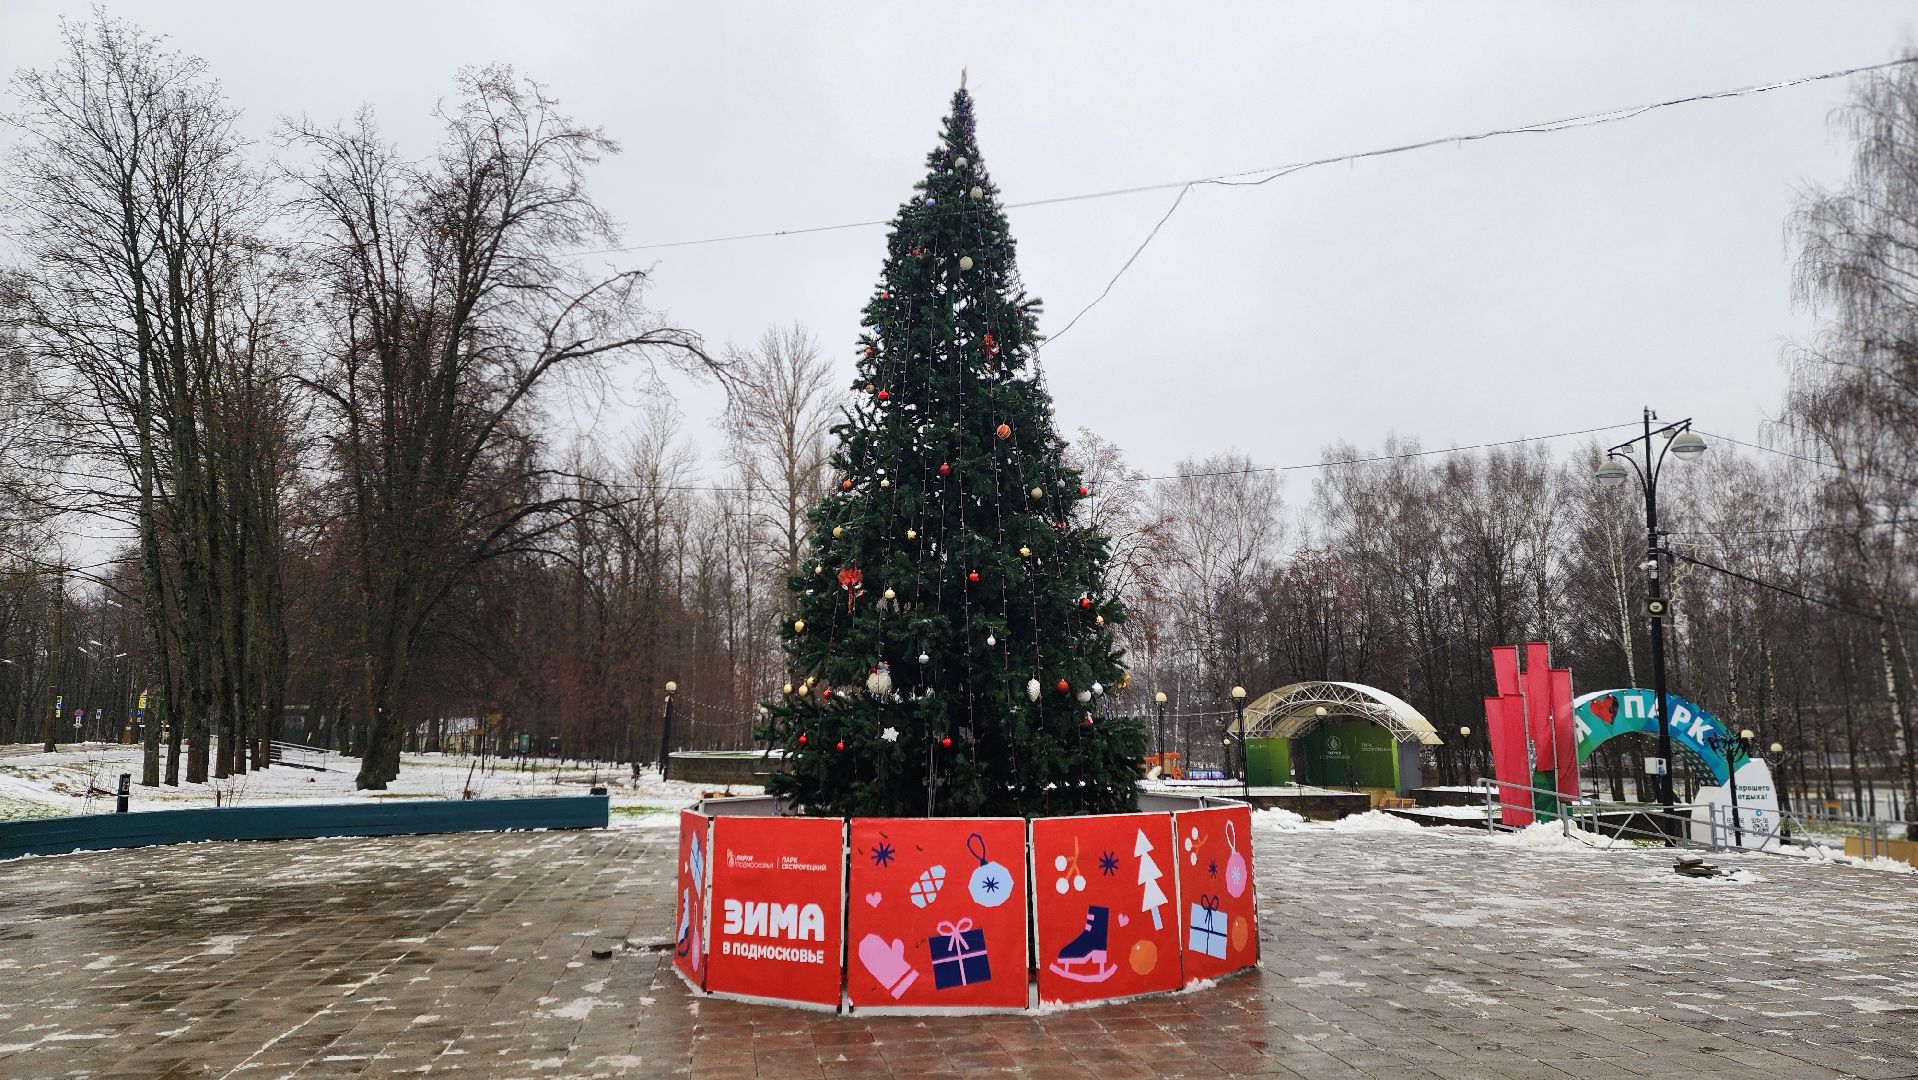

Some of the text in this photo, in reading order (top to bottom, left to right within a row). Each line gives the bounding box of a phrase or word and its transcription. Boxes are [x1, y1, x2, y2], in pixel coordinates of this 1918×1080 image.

[723, 898, 825, 942] ЗИМА
[722, 941, 825, 964] В ПОДМОСКОВЬЕ
